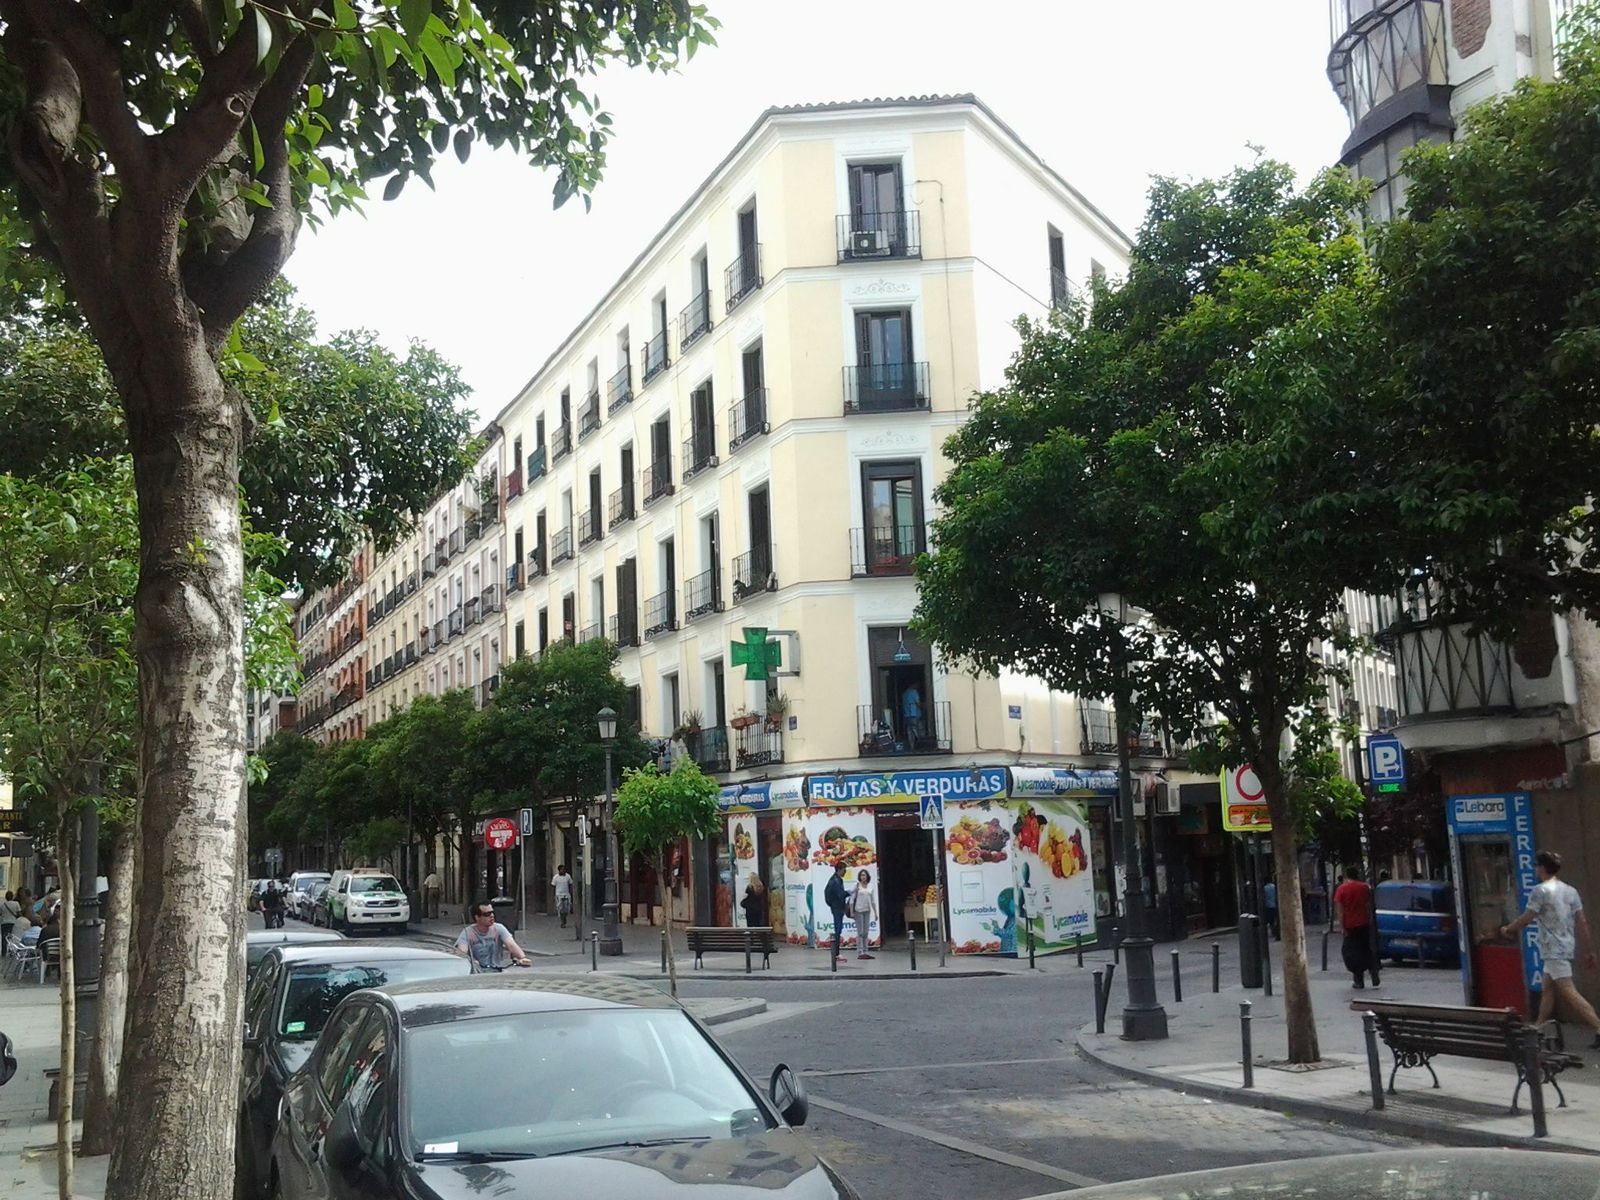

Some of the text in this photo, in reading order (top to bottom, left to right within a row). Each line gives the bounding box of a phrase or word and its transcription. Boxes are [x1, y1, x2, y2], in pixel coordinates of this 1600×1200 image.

[1374, 746, 1397, 774] P
[812, 775, 1002, 800] FRUTAS Y VERDURAS
[1016, 776, 1055, 792] Lycamobile
[740, 793, 765, 804] VERDURAS
[1464, 801, 1504, 813] Lebara
[1513, 796, 1543, 987] FERRERIA
[952, 905, 997, 916] Lycamobile
[816, 920, 877, 932] Lycmoe
[1052, 910, 1089, 930] Lycamobile
